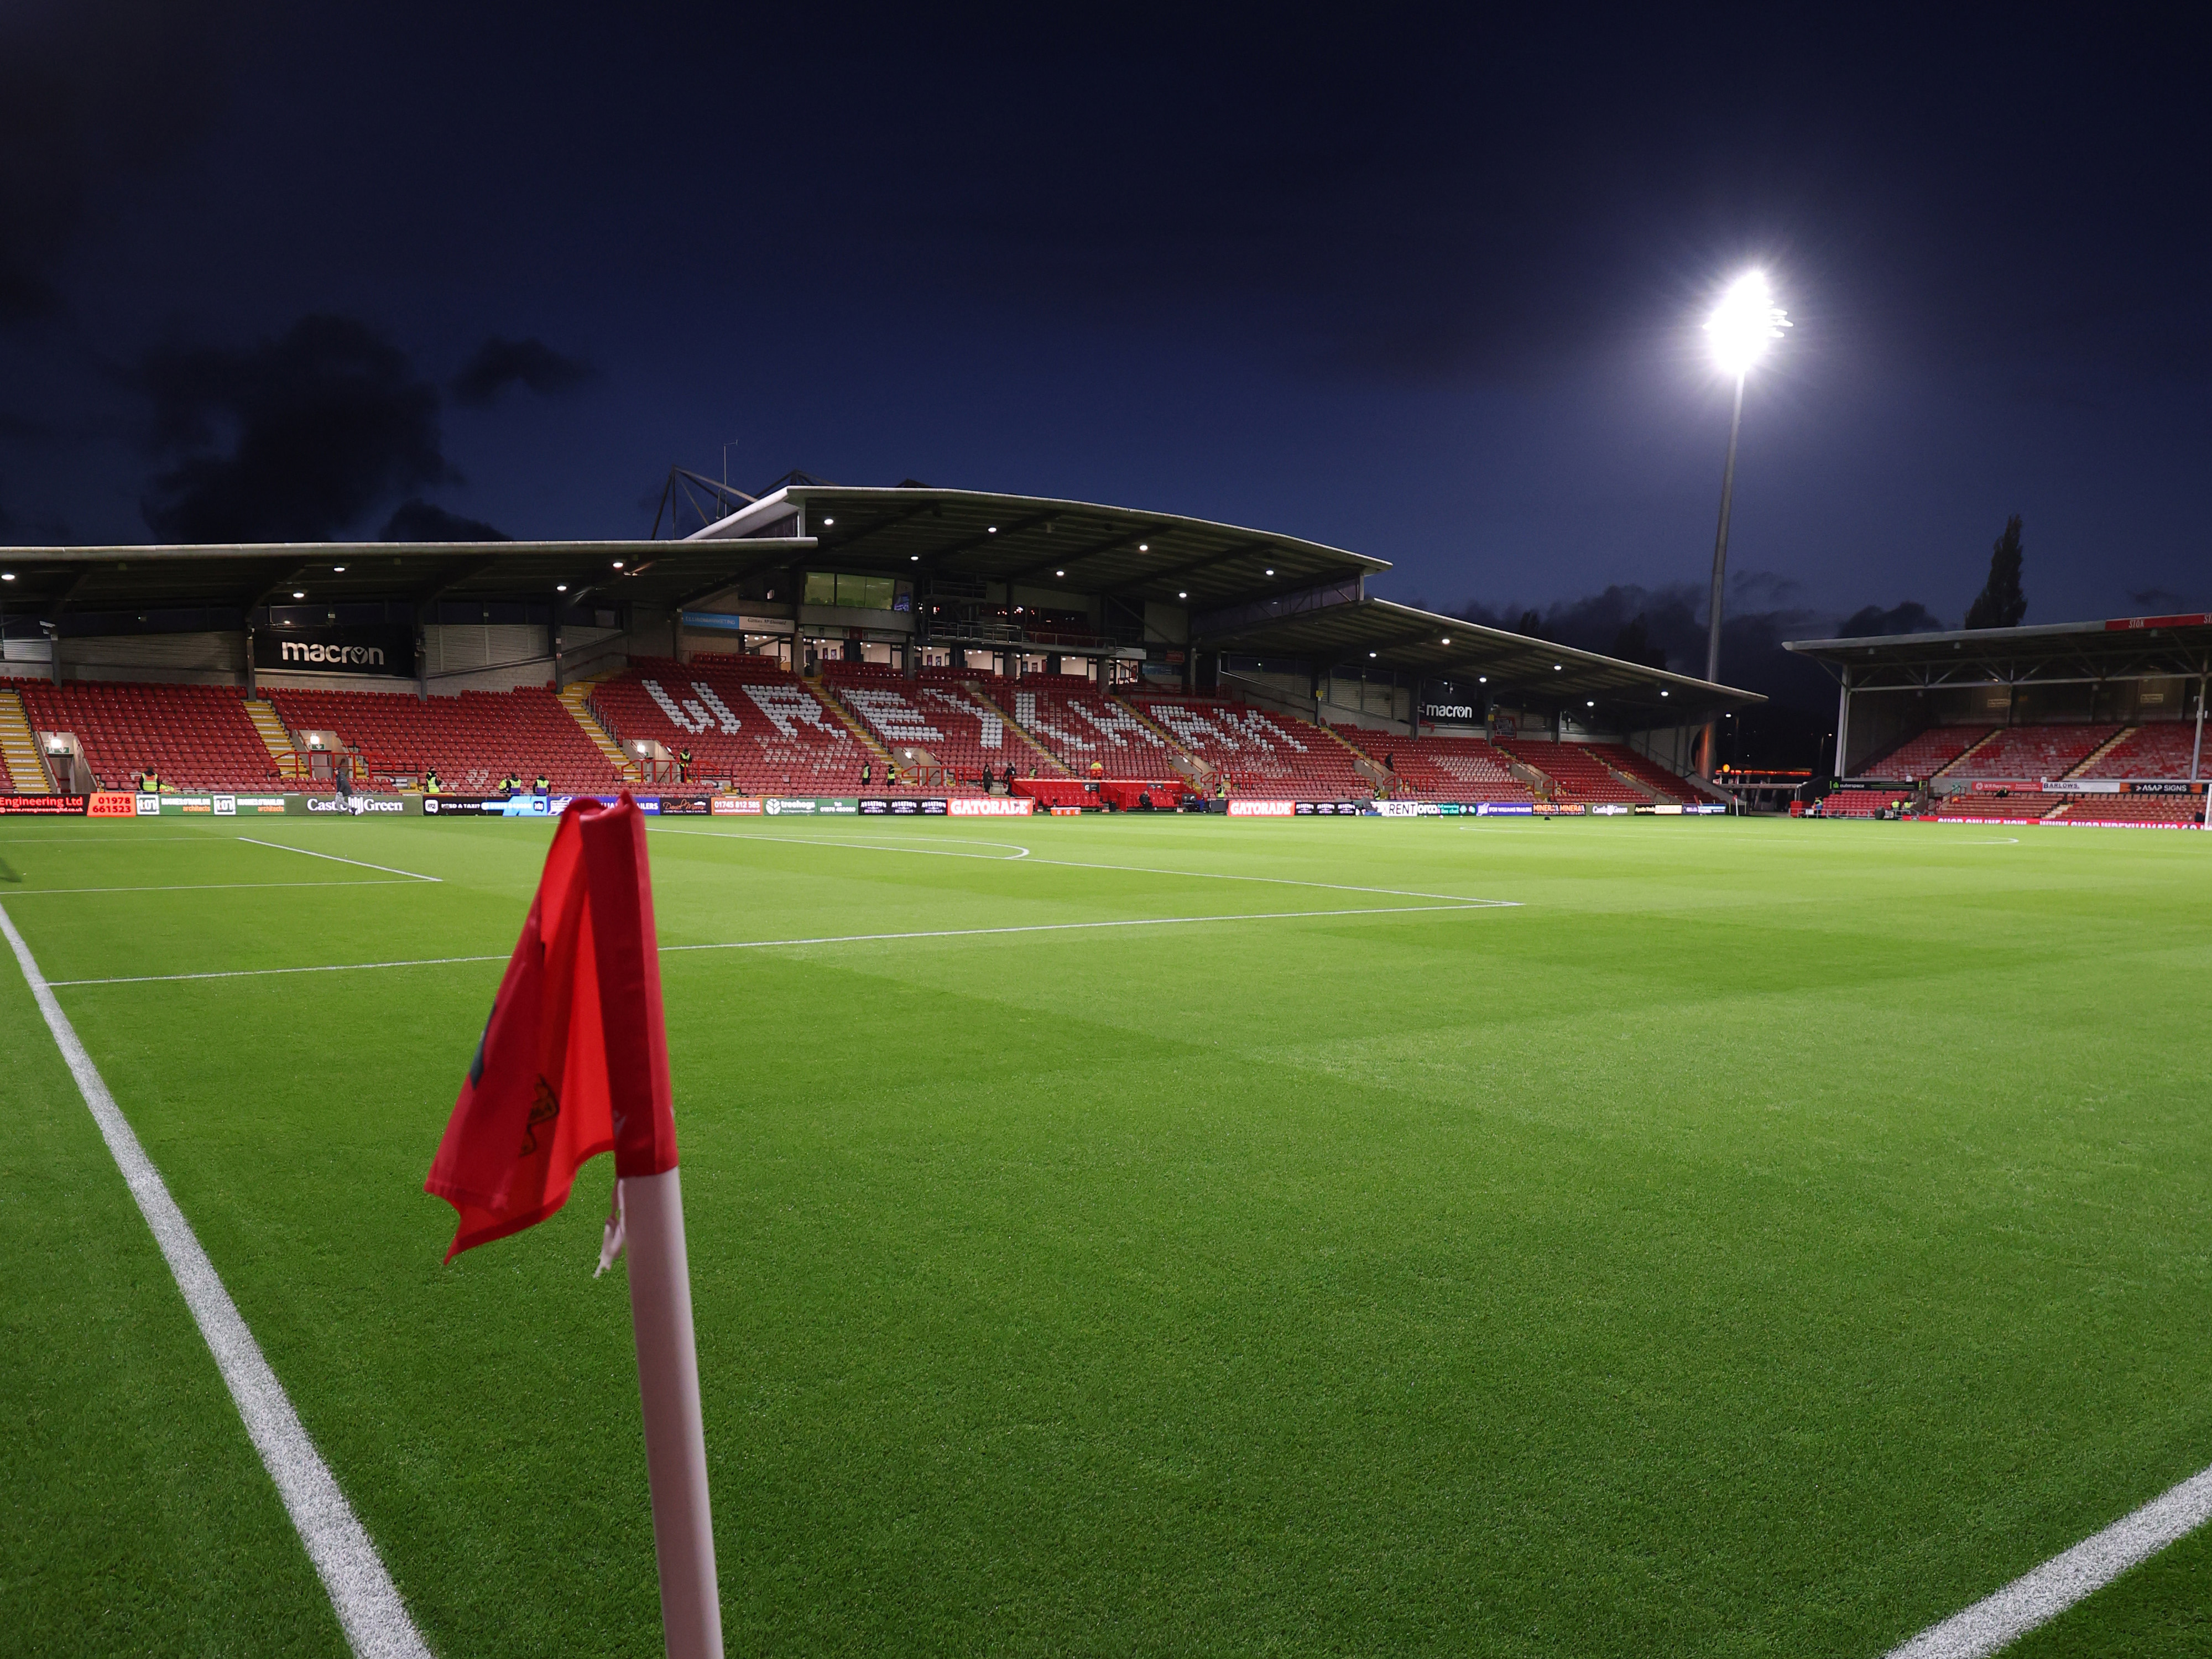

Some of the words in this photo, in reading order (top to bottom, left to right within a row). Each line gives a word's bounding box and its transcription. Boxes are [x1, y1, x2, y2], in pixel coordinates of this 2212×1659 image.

[2204, 614, 2212, 624] ST
[282, 642, 384, 665] macron
[1426, 704, 1472, 718] macron
[0, 796, 65, 807] Engineering
[66, 797, 83, 805] Ltd
[307, 799, 347, 811] Caste
[364, 799, 403, 811] Green
[781, 800, 815, 809] treehogs
[951, 800, 1027, 815] GATORADE
[1230, 802, 1291, 815] GATORADE
[1417, 805, 1438, 814] orca
[1592, 805, 1608, 813] Castle
[1613, 805, 1627, 813] Green
